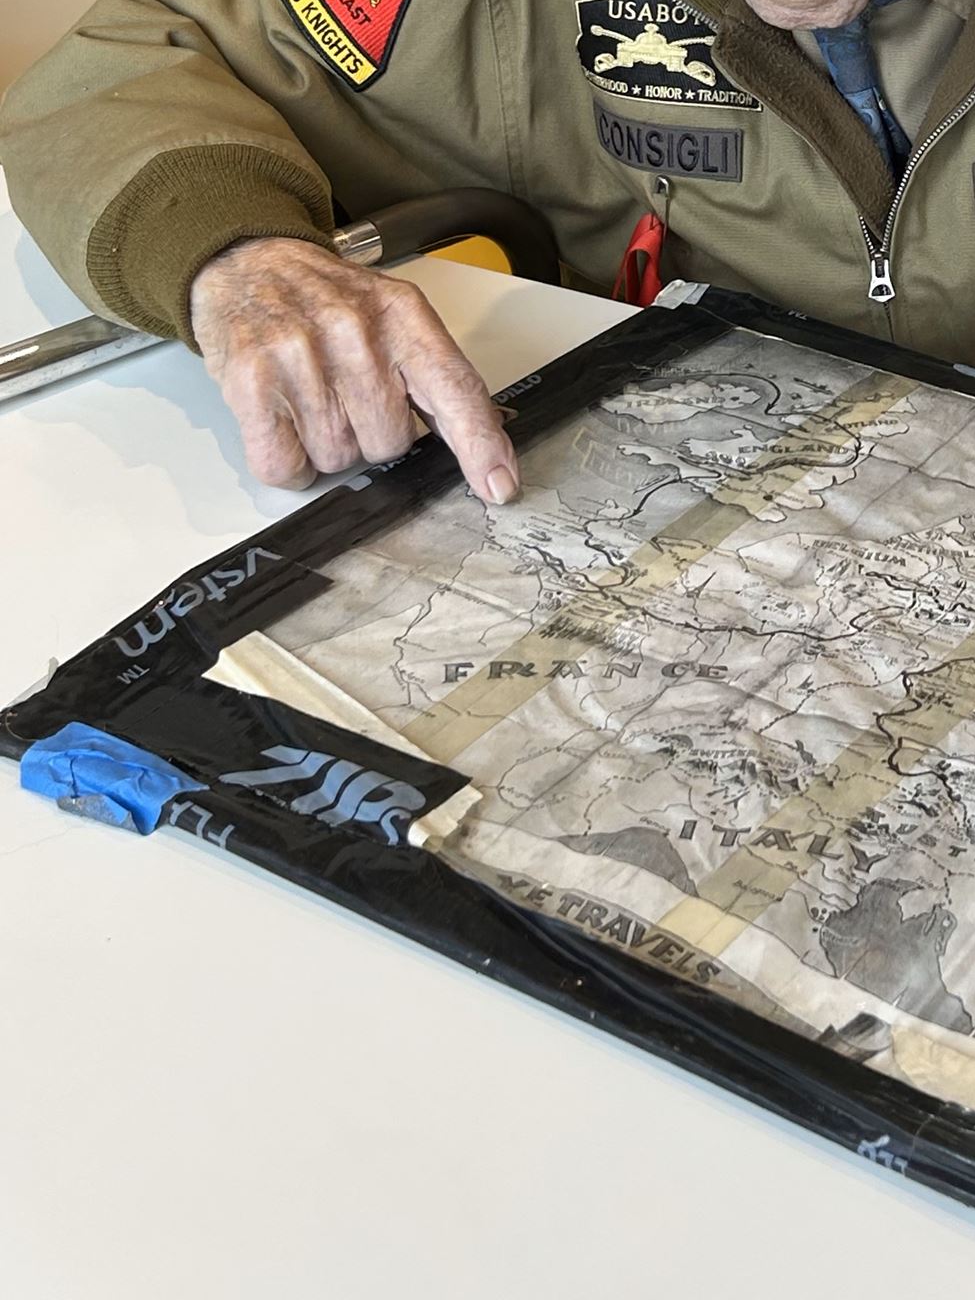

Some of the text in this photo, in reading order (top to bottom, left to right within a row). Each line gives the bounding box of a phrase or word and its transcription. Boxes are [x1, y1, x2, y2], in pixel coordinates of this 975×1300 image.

[301, 2, 364, 75] KNIGHTS
[645, 86, 683, 100] HONOR
[697, 88, 752, 106] TRADITION
[600, 113, 729, 175] CONSIGLI
[737, 444, 851, 455] ENGLAND
[442, 659, 729, 684] FRANCE
[678, 818, 889, 874] ITALY
[556, 890, 722, 986] TRAVELS
